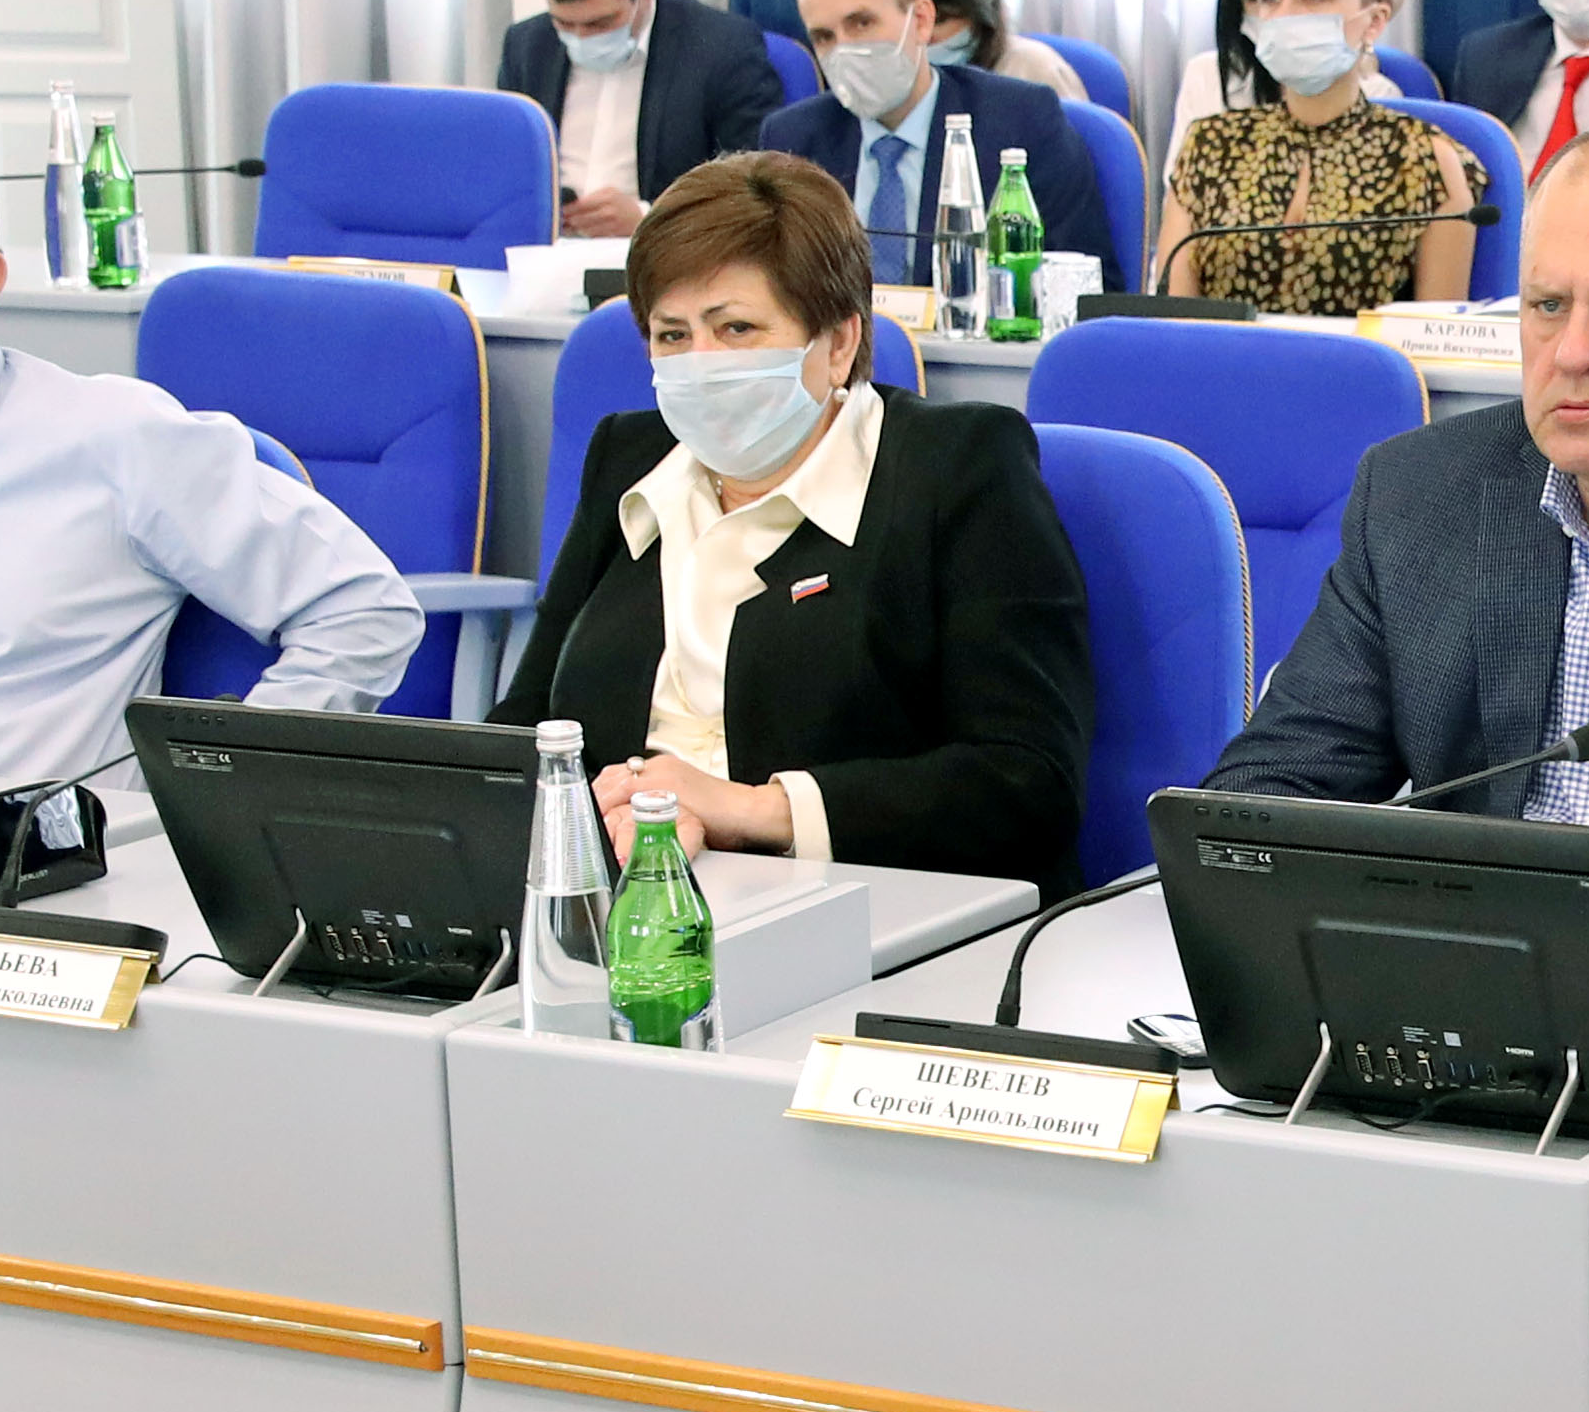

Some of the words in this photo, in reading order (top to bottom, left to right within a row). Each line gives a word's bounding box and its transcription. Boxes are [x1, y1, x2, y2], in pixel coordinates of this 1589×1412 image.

[1424, 322, 1497, 338] КАРЛОВА
[916, 1062, 1052, 1097] ШЕВЕЛЕВ
[852, 1086, 933, 1116] Сергей
[939, 1100, 1100, 1137] Арнольдович
